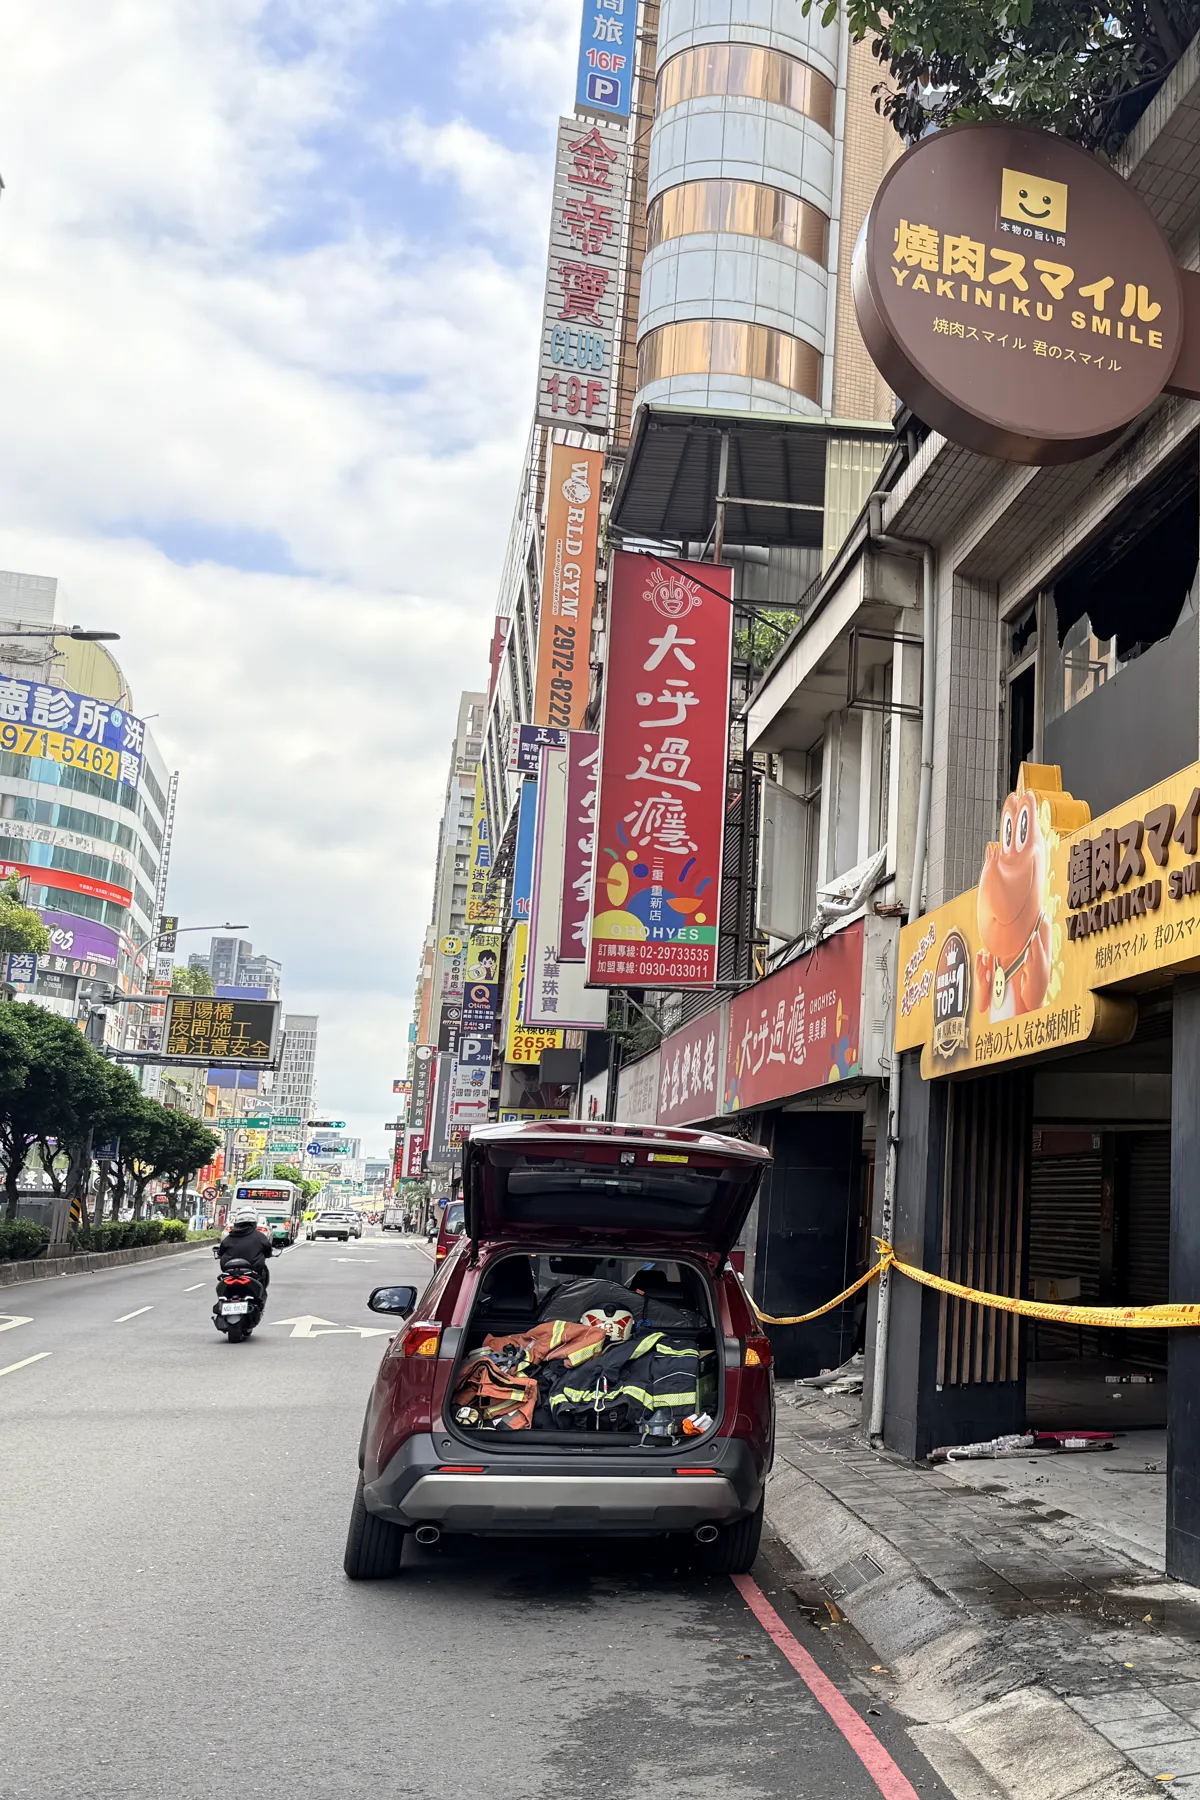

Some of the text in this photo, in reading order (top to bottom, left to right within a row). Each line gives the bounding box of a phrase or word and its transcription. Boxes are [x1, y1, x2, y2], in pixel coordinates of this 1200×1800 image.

[586, 48, 626, 72] 16F
[558, 127, 617, 326] 金帝寶
[1000, 222, 1066, 247] 本物の旨い肉
[892, 219, 1162, 323] 燒肉スマイル
[891, 267, 1163, 349] YAKINIKU SMILE
[551, 324, 604, 370] CLUB
[932, 317, 1122, 372] 焼肉スマイル 君のスマイル
[548, 373, 603, 418] 19F
[561, 562, 581, 624] GYM
[548, 624, 576, 727] 2972-8222
[122, 716, 144, 788] 洗腎
[624, 624, 701, 854] 大呼過癮
[649, 856, 664, 921] 三重 重新店
[1065, 879, 1161, 941] YAKINIKU
[611, 924, 699, 941] OHOHYES
[11, 954, 34, 982] 洗腎
[72, 960, 97, 977] PUB
[541, 946, 560, 1013] 光華珠寶
[937, 963, 965, 1018] TOP 1
[172, 1000, 234, 1021] 重陽橋
[810, 989, 836, 1015] OHOHYES
[167, 1036, 270, 1059] 請注意安全
[170, 1018, 252, 1040] 夜間施工
[462, 1040, 481, 1060] P
[514, 1036, 556, 1048] 2653
[738, 986, 807, 1080] 大呼過癮
[808, 1016, 827, 1044] 臭臭鍋
[974, 1003, 1081, 1061] 台湾の大人気な焼肉店
